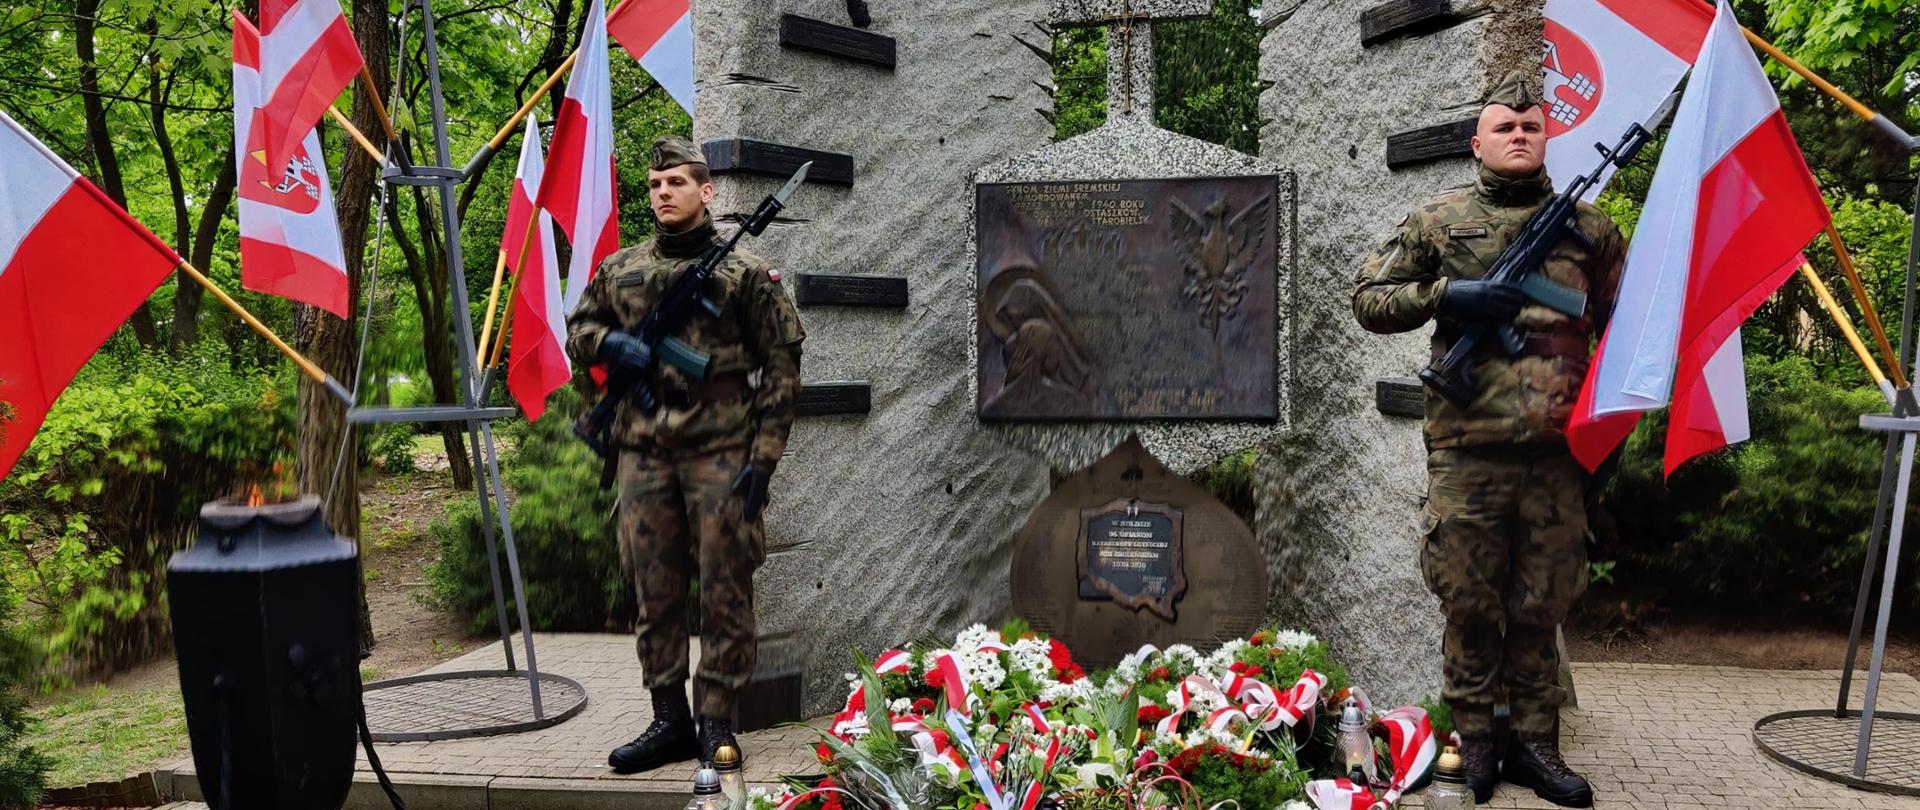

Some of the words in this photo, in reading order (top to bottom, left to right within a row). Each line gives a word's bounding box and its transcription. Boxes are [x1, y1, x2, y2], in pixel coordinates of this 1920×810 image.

[1043, 184, 1069, 194] ZIEMI
[1091, 199, 1116, 209] 1940
[1119, 199, 1144, 209] ROKU
